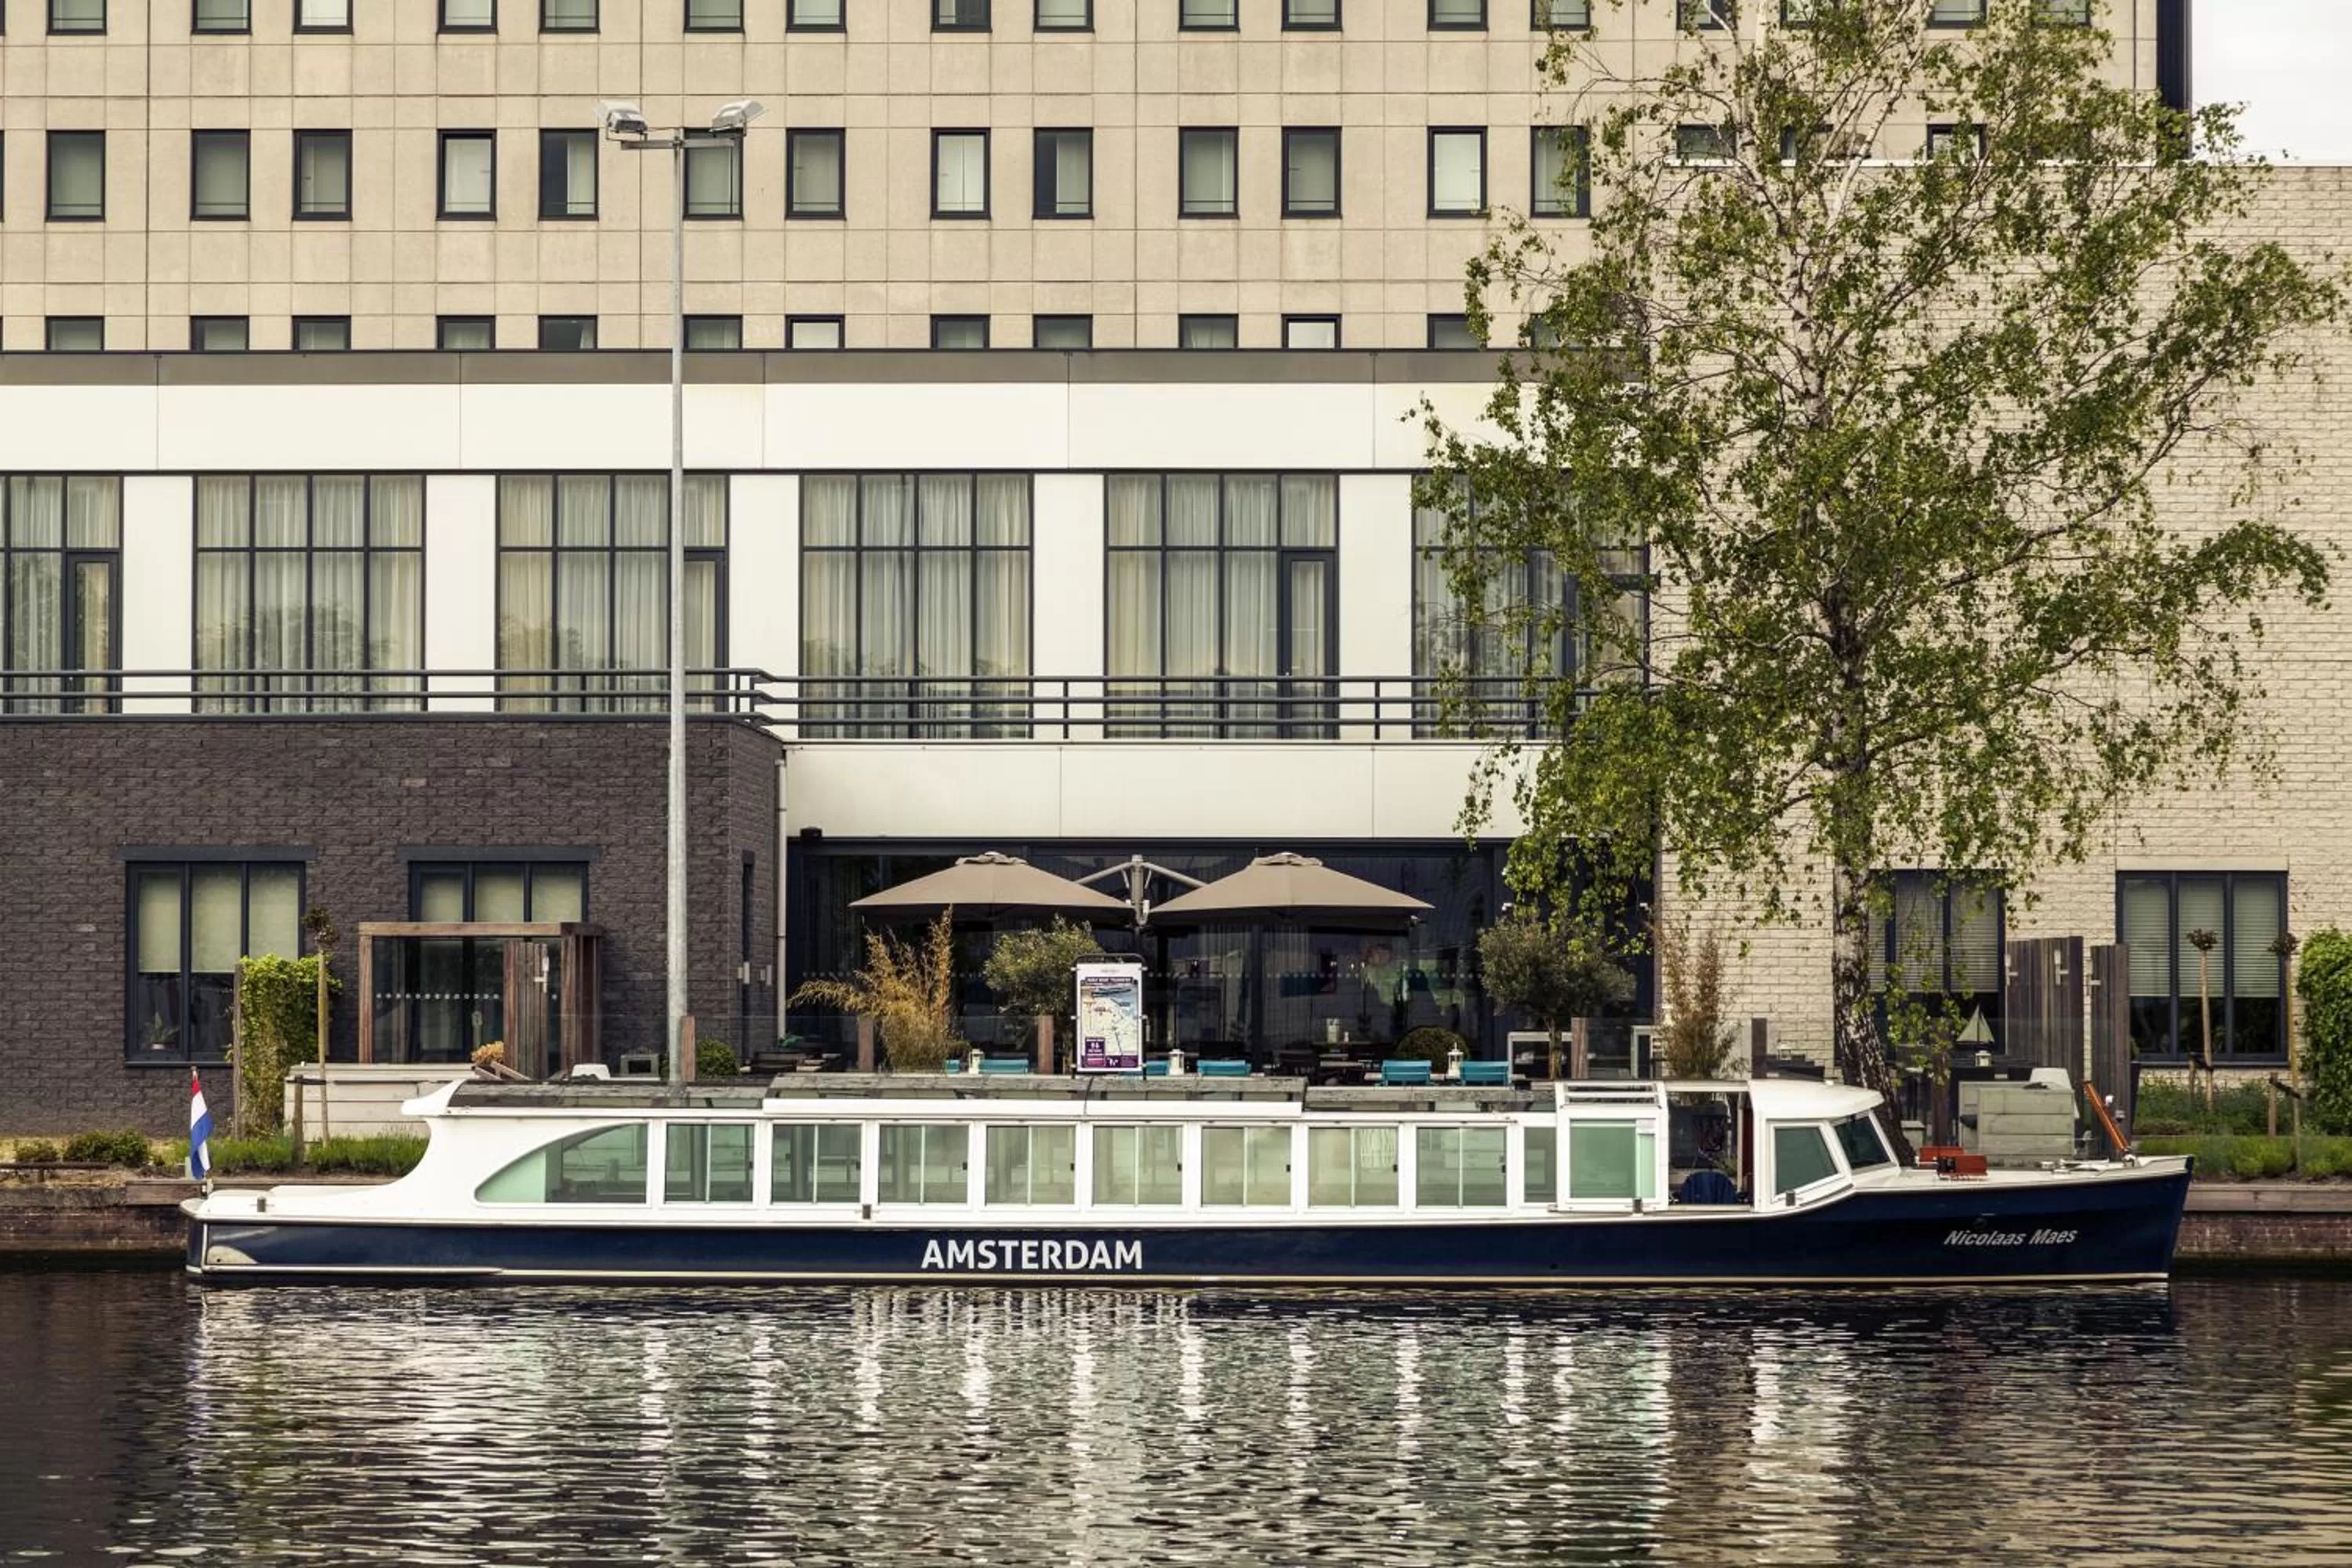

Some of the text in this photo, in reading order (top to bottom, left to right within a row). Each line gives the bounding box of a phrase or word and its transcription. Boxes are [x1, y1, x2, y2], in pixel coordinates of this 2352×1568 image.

[1944, 1229, 2078, 1245] Nicolaas Maes
[921, 1240, 1142, 1269] AMSTERDAM
